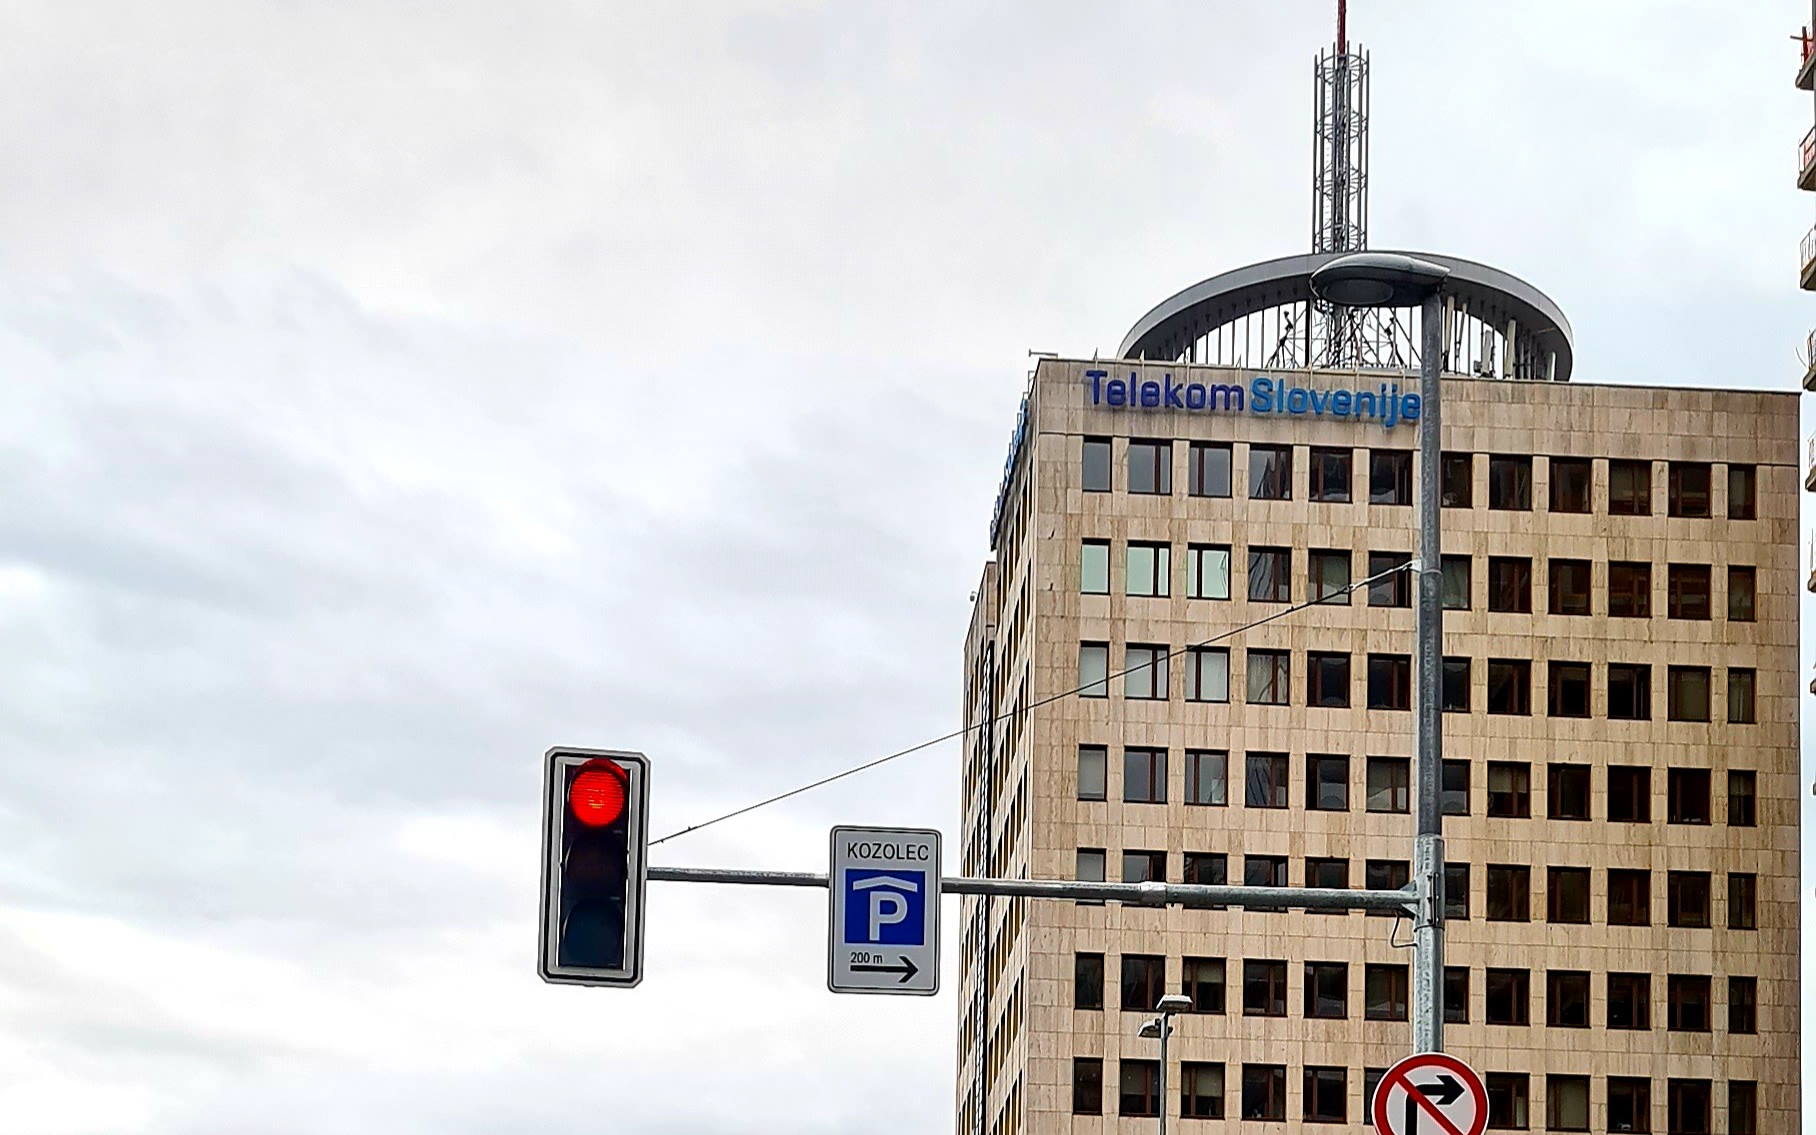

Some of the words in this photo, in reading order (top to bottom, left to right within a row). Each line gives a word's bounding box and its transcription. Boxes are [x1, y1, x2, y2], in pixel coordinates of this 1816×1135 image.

[1086, 370, 1244, 411] Telekom
[1251, 377, 1421, 427] Slovenije
[847, 842, 929, 861] KOZOLEC
[869, 891, 908, 941] P
[850, 952, 870, 963] 200
[872, 954, 883, 963] m
